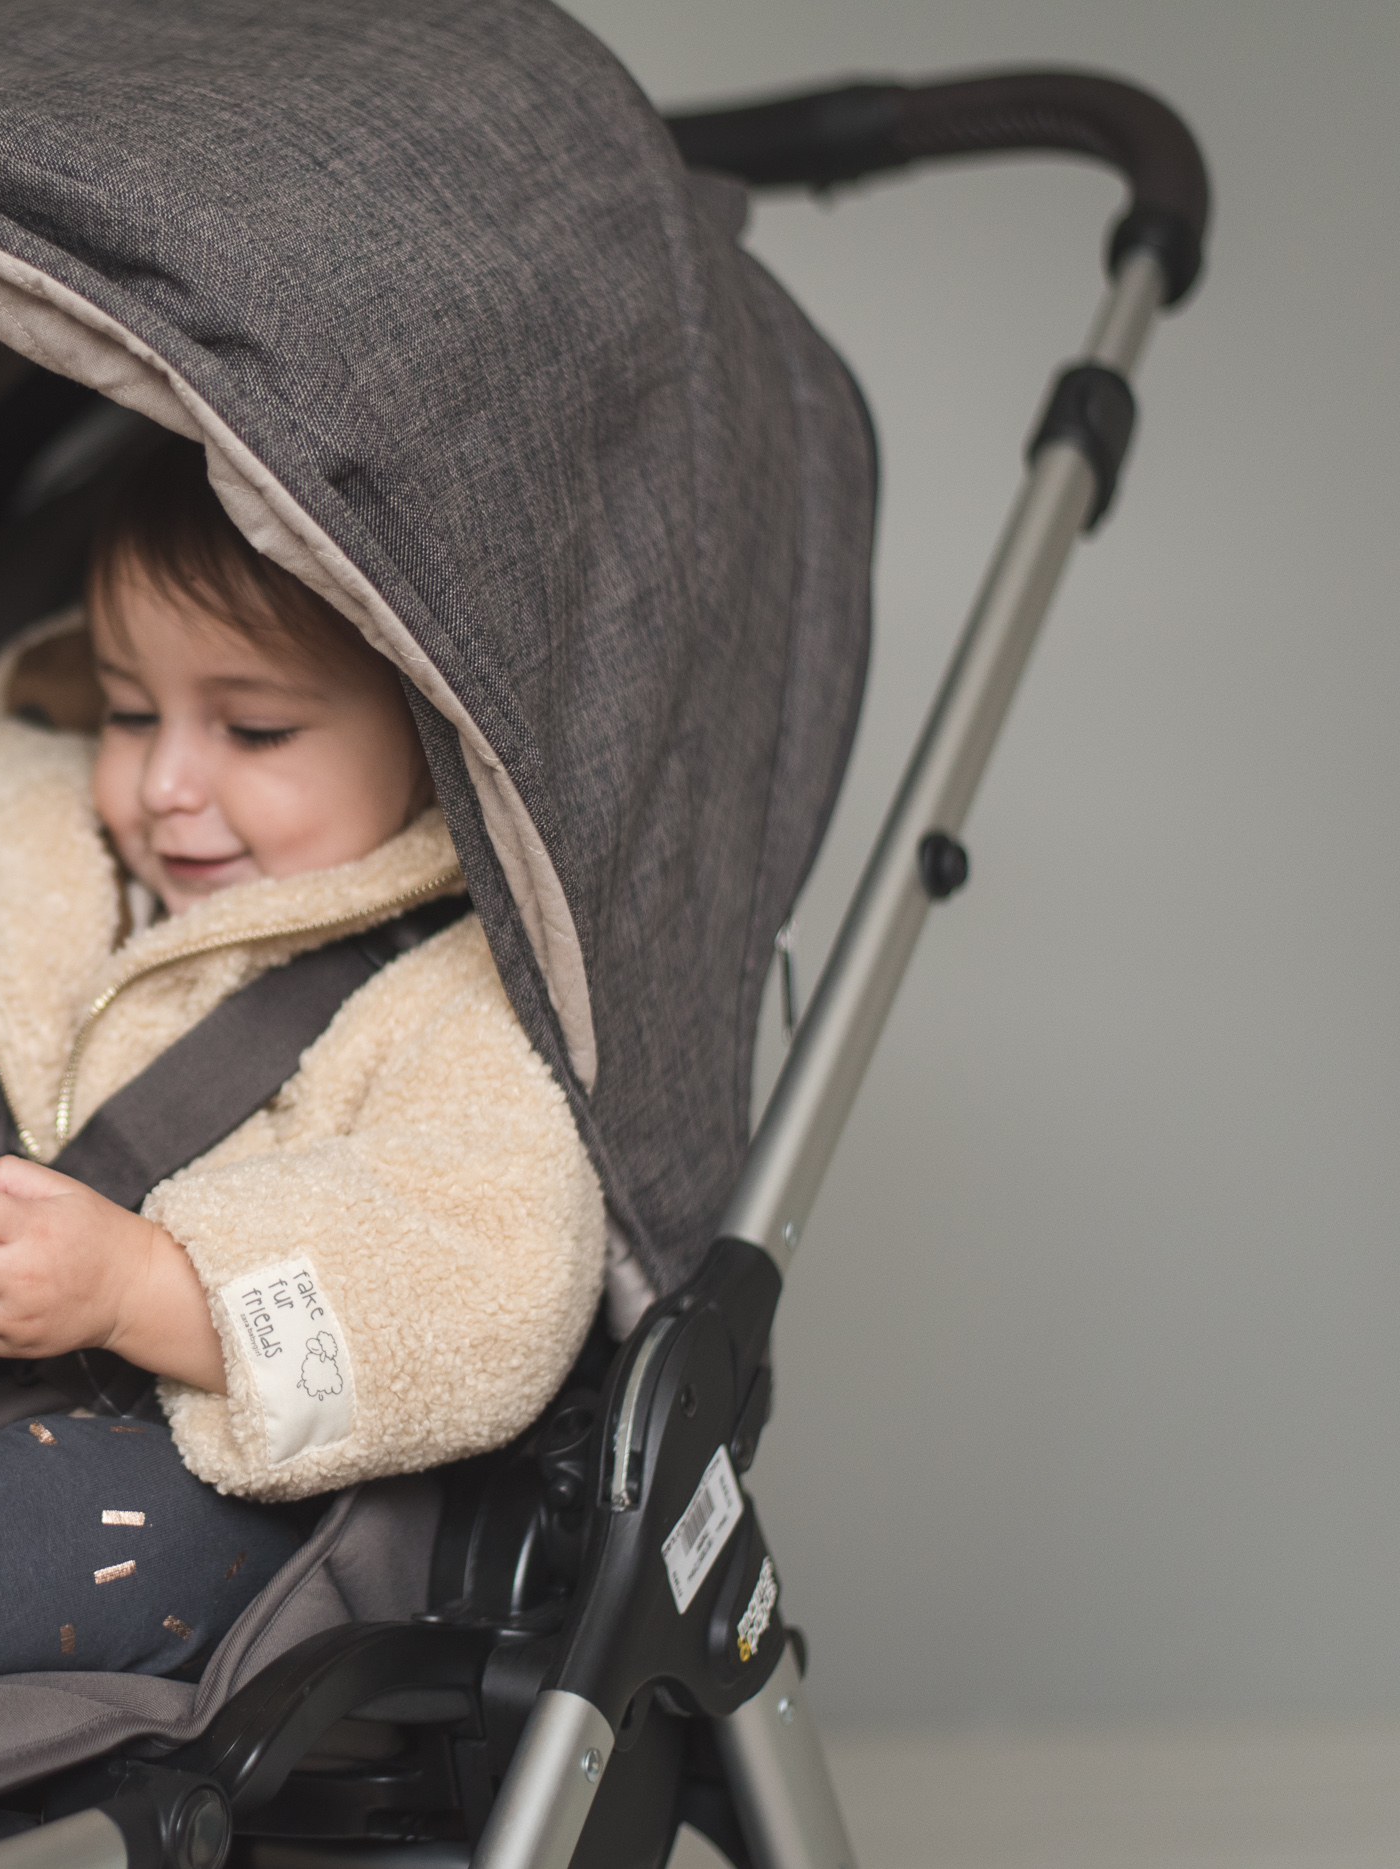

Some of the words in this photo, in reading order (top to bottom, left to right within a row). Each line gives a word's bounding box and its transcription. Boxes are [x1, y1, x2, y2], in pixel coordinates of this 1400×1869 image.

[268, 1278, 294, 1309] fur
[293, 1269, 324, 1321] fake
[240, 1313, 250, 1328] zara
[247, 1328, 262, 1357] babygirl
[241, 1288, 283, 1359] friends
[737, 1555, 774, 1641] mamas
